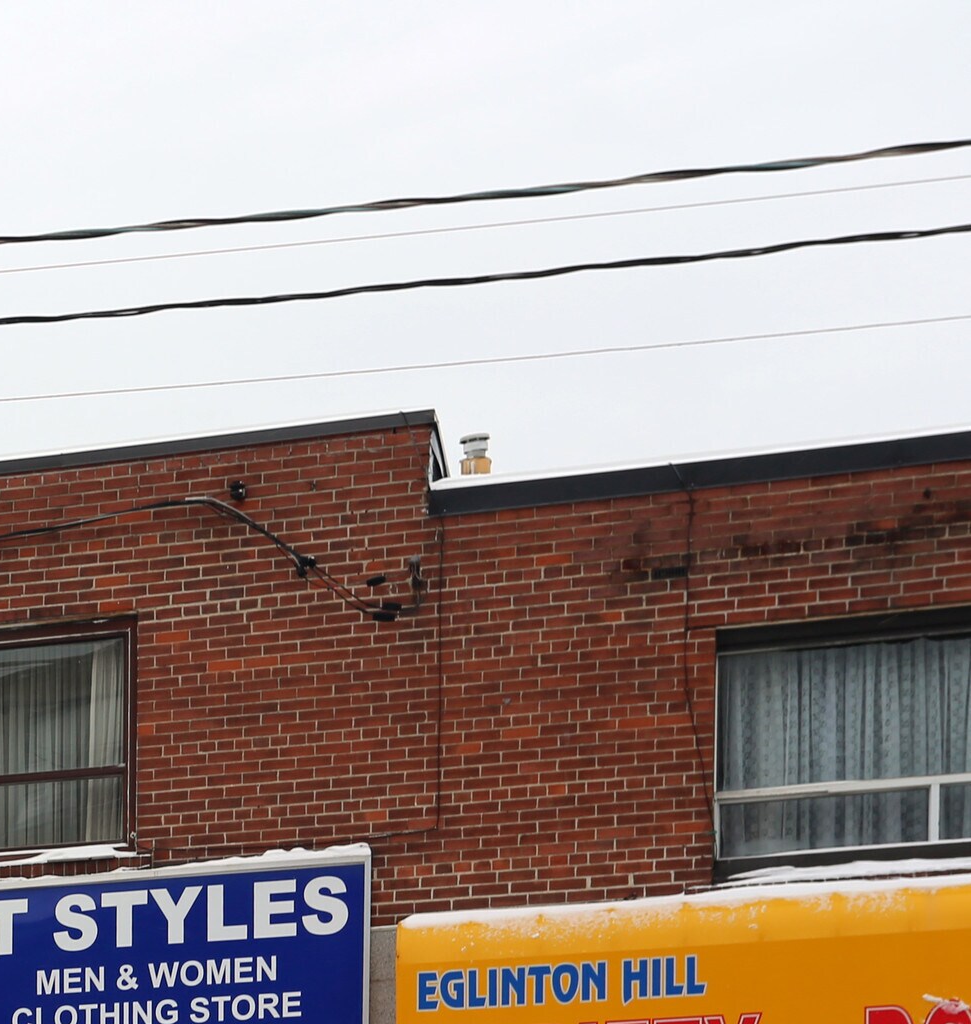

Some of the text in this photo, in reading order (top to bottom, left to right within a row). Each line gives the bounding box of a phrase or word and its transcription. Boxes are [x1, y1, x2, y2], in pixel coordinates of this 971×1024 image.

[52, 875, 349, 952] STYLES
[36, 955, 277, 996] MEN & WOMEN
[416, 954, 707, 1012] EGLINTON HILL
[189, 991, 303, 1023] STORE
